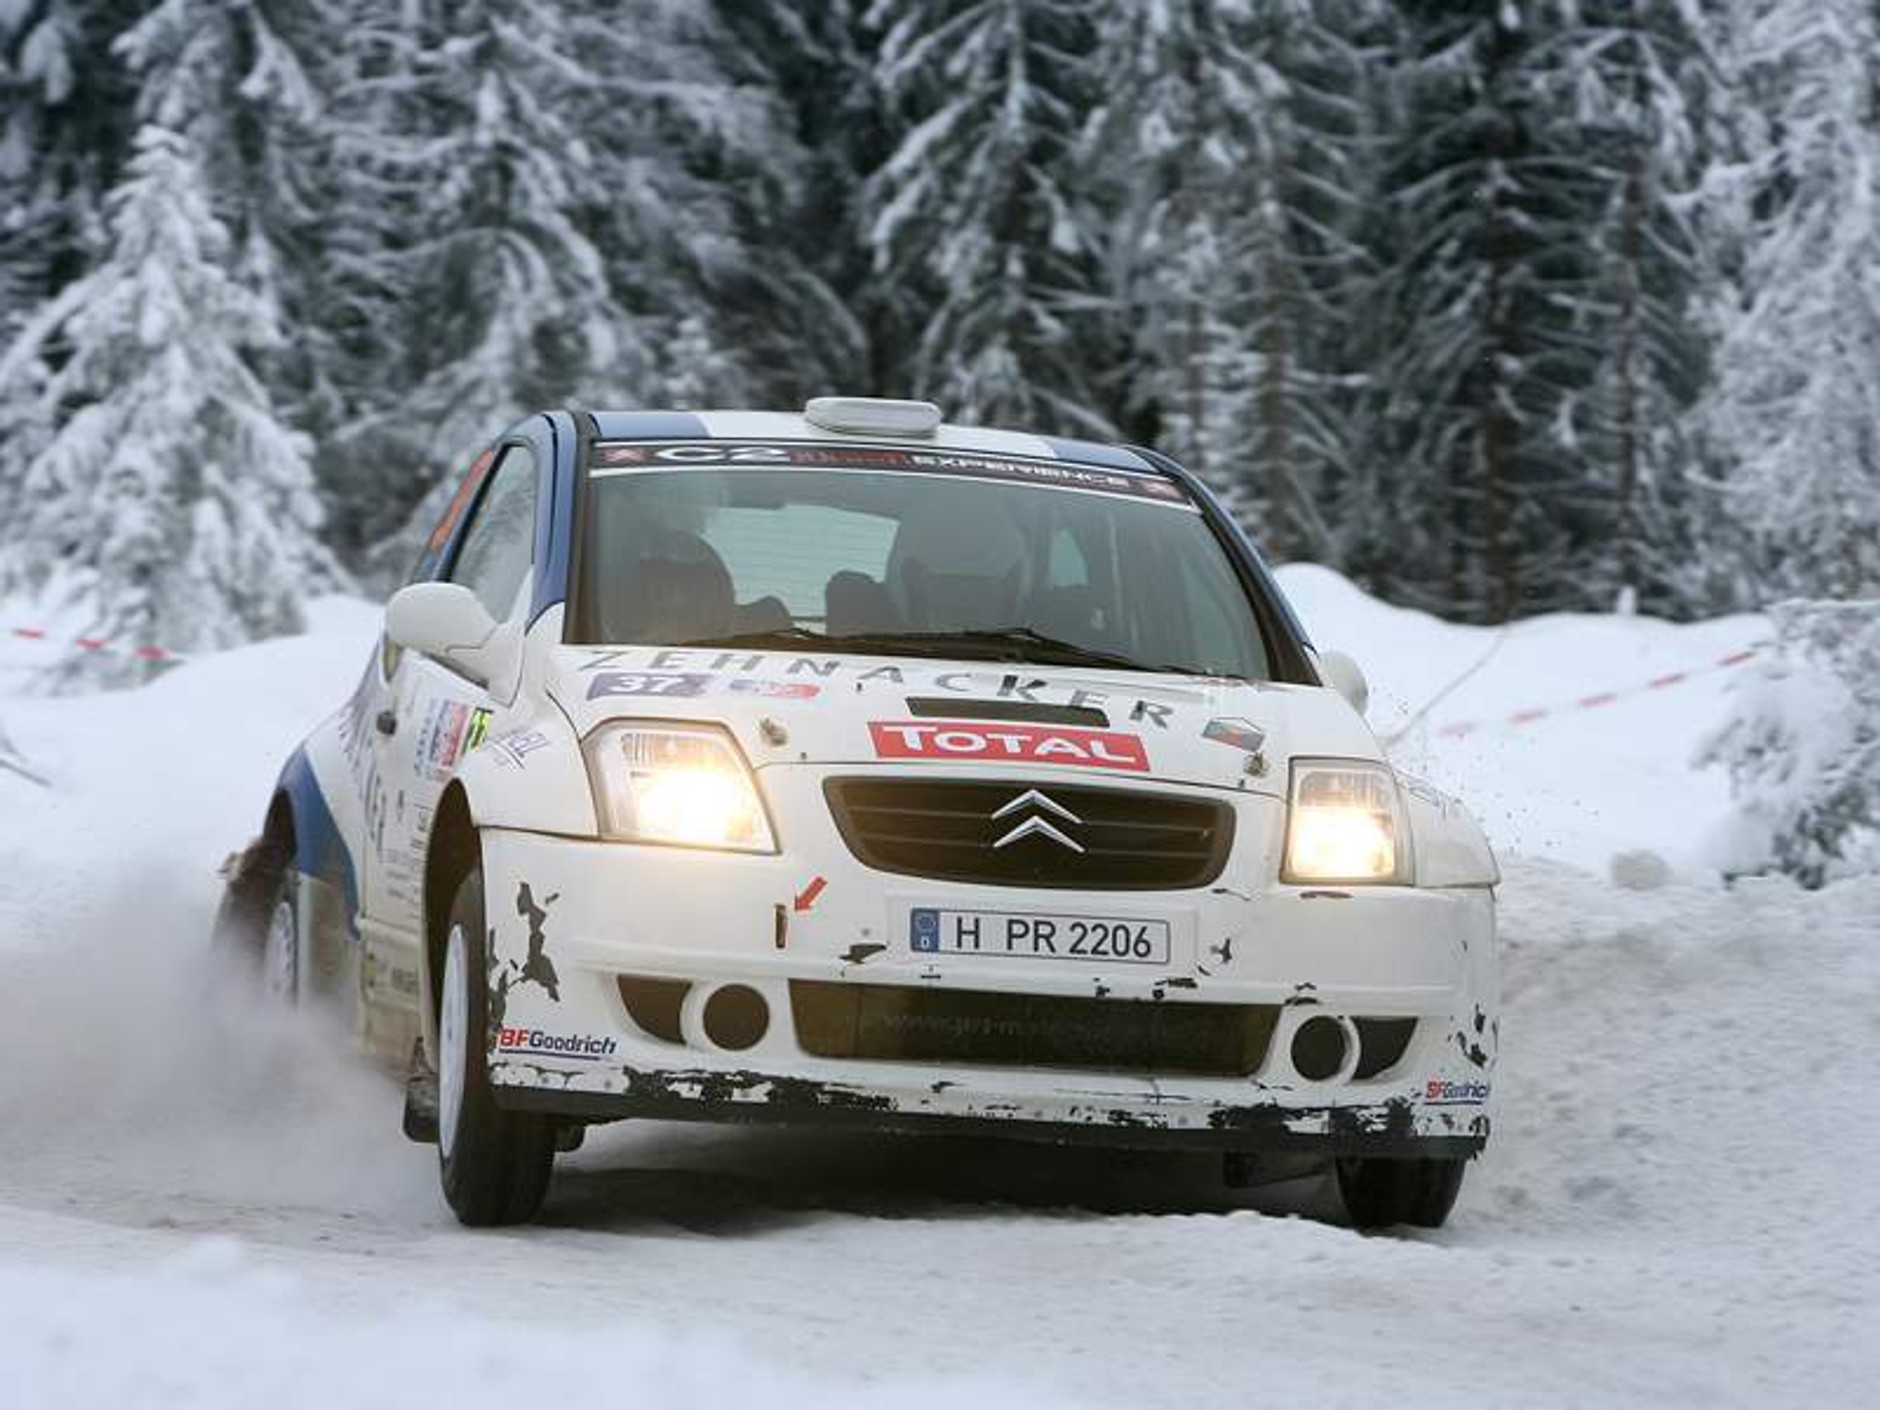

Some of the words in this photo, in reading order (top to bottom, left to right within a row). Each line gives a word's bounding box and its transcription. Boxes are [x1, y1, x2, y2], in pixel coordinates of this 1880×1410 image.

[655, 446, 790, 463] C2
[578, 650, 1174, 729] ZEHNACKER
[608, 676, 685, 693] 37
[882, 725, 1136, 763] TOTAL
[956, 916, 981, 949] H
[1006, 919, 1056, 952] PR
[1068, 922, 1151, 957] 2206
[499, 1028, 617, 1055] BFGoodrich
